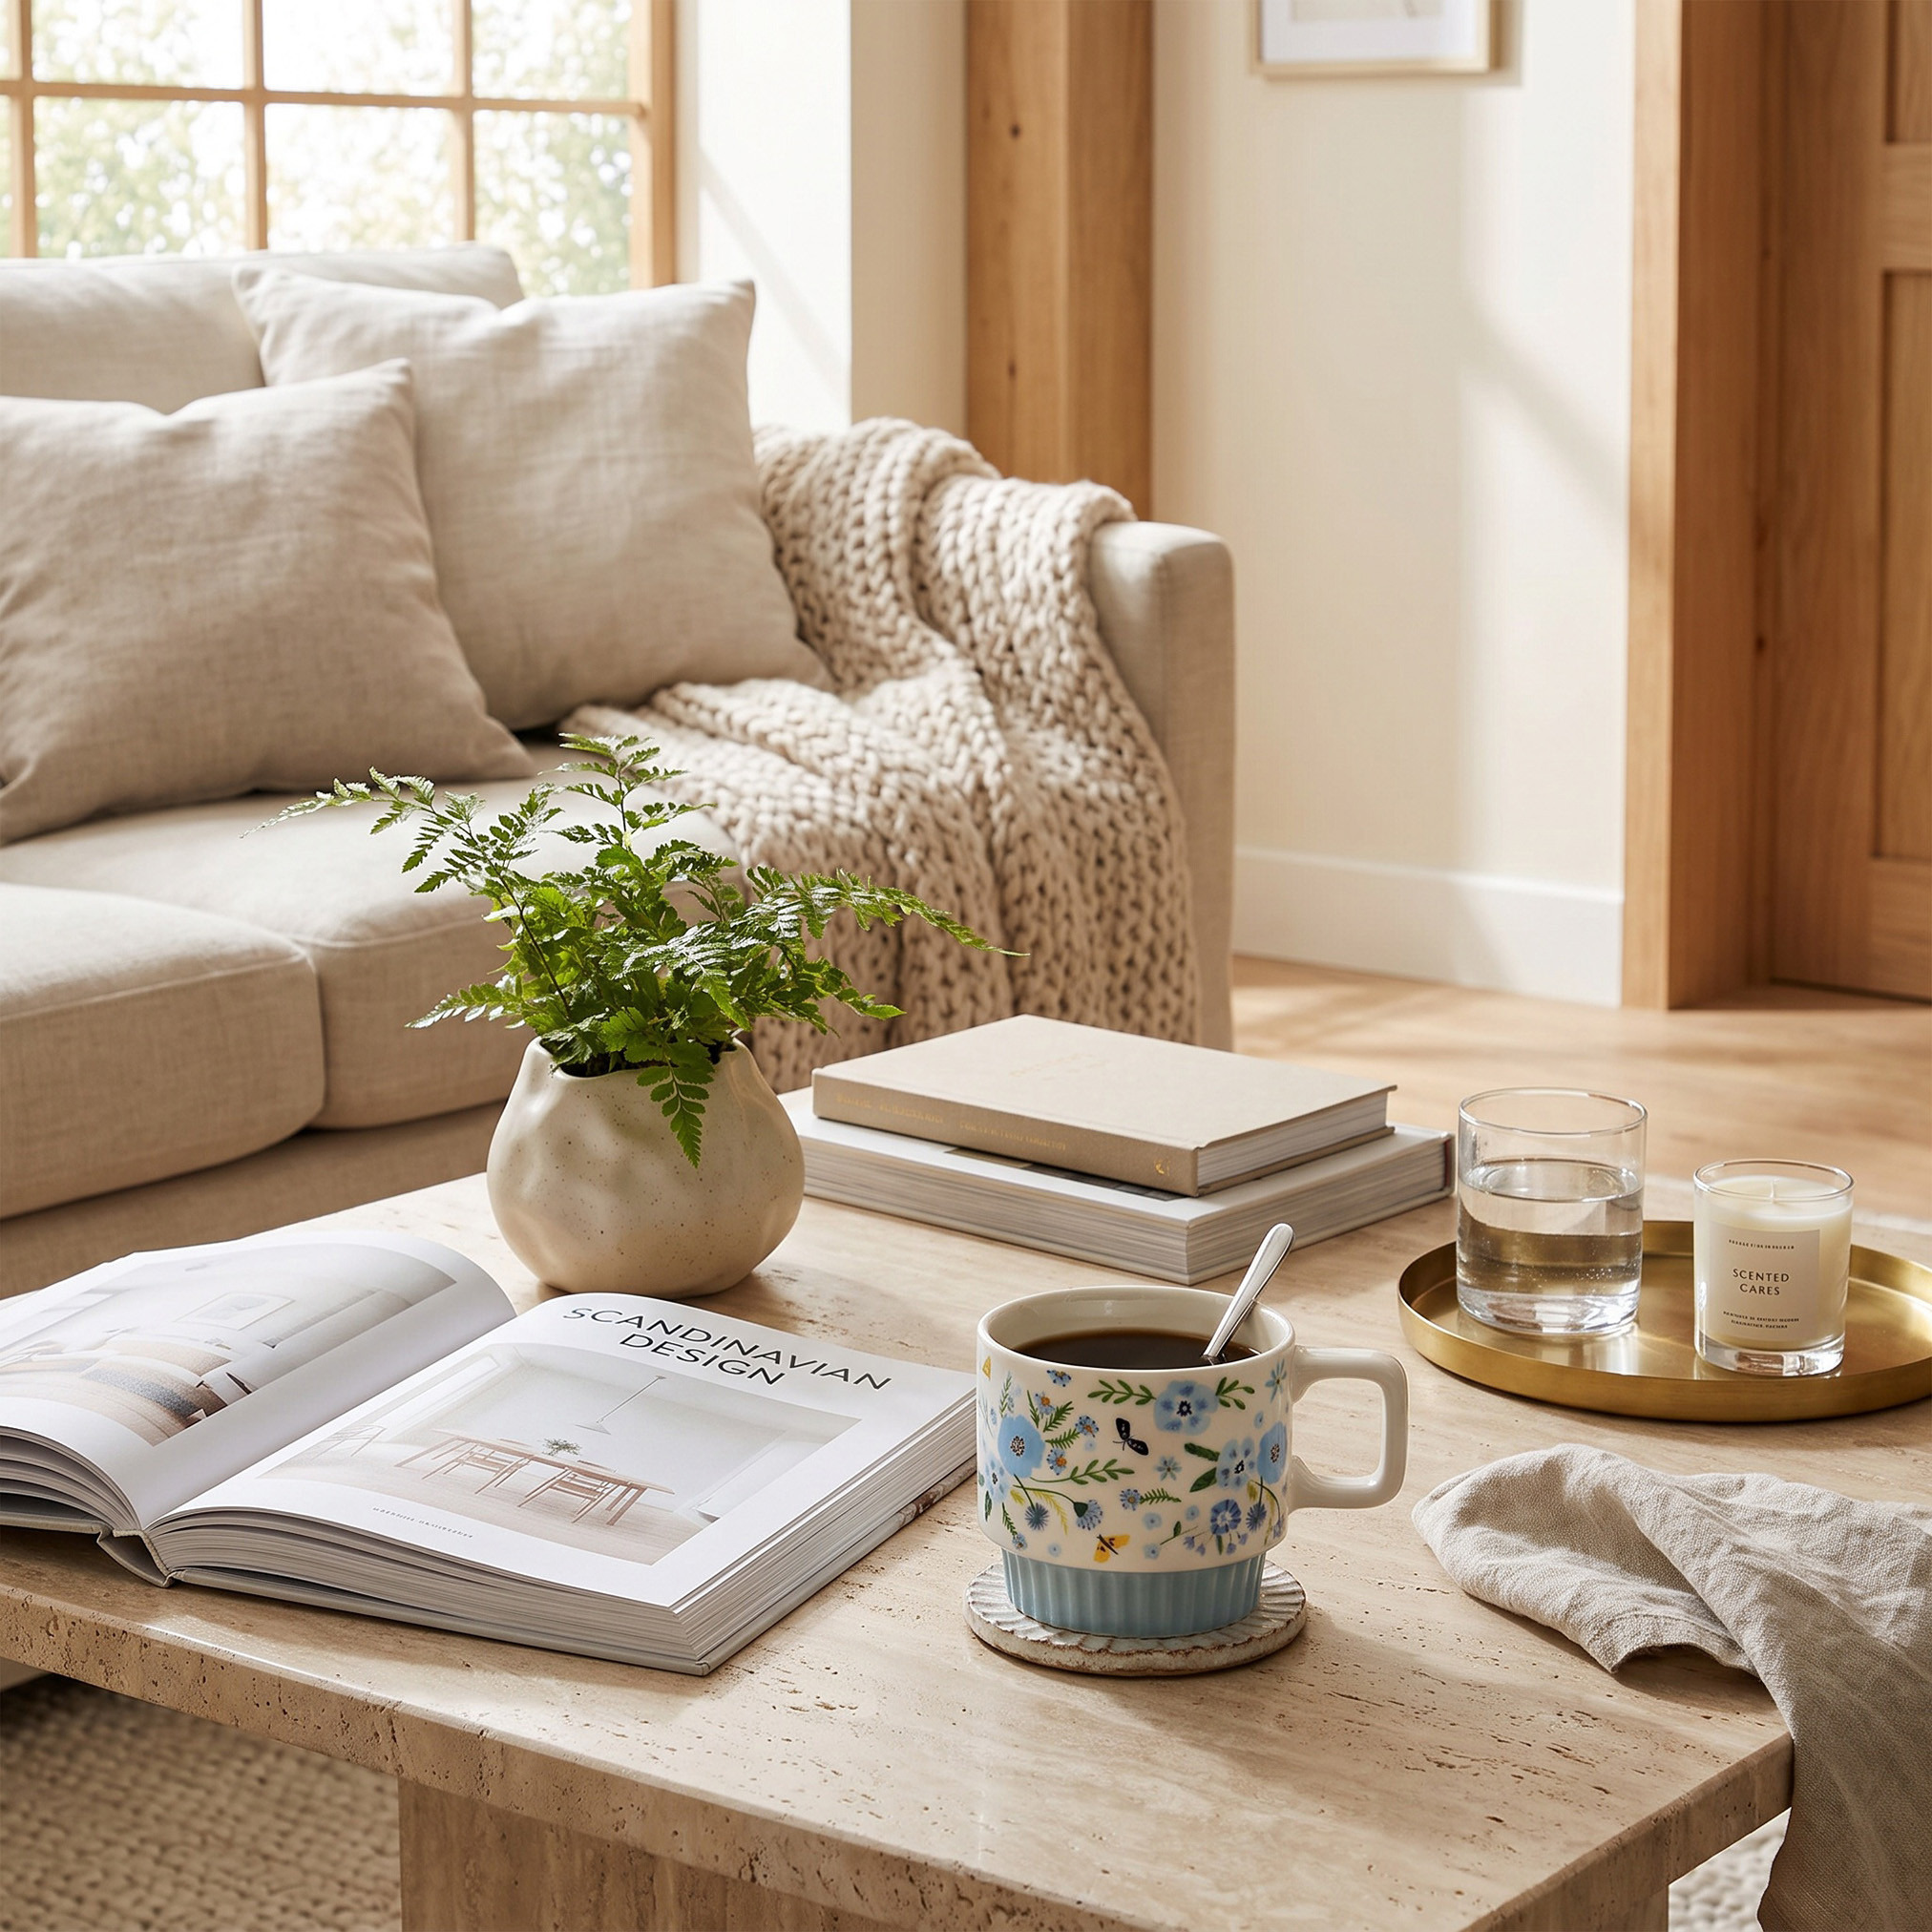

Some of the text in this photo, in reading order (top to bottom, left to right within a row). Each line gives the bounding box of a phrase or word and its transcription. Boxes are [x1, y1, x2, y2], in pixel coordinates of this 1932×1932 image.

[1732, 1269, 1790, 1283] SCENTED
[1739, 1283, 1780, 1296] CARES
[562, 1307, 892, 1390] SCANDINAVIAN
[620, 1334, 786, 1385] DESIGN
